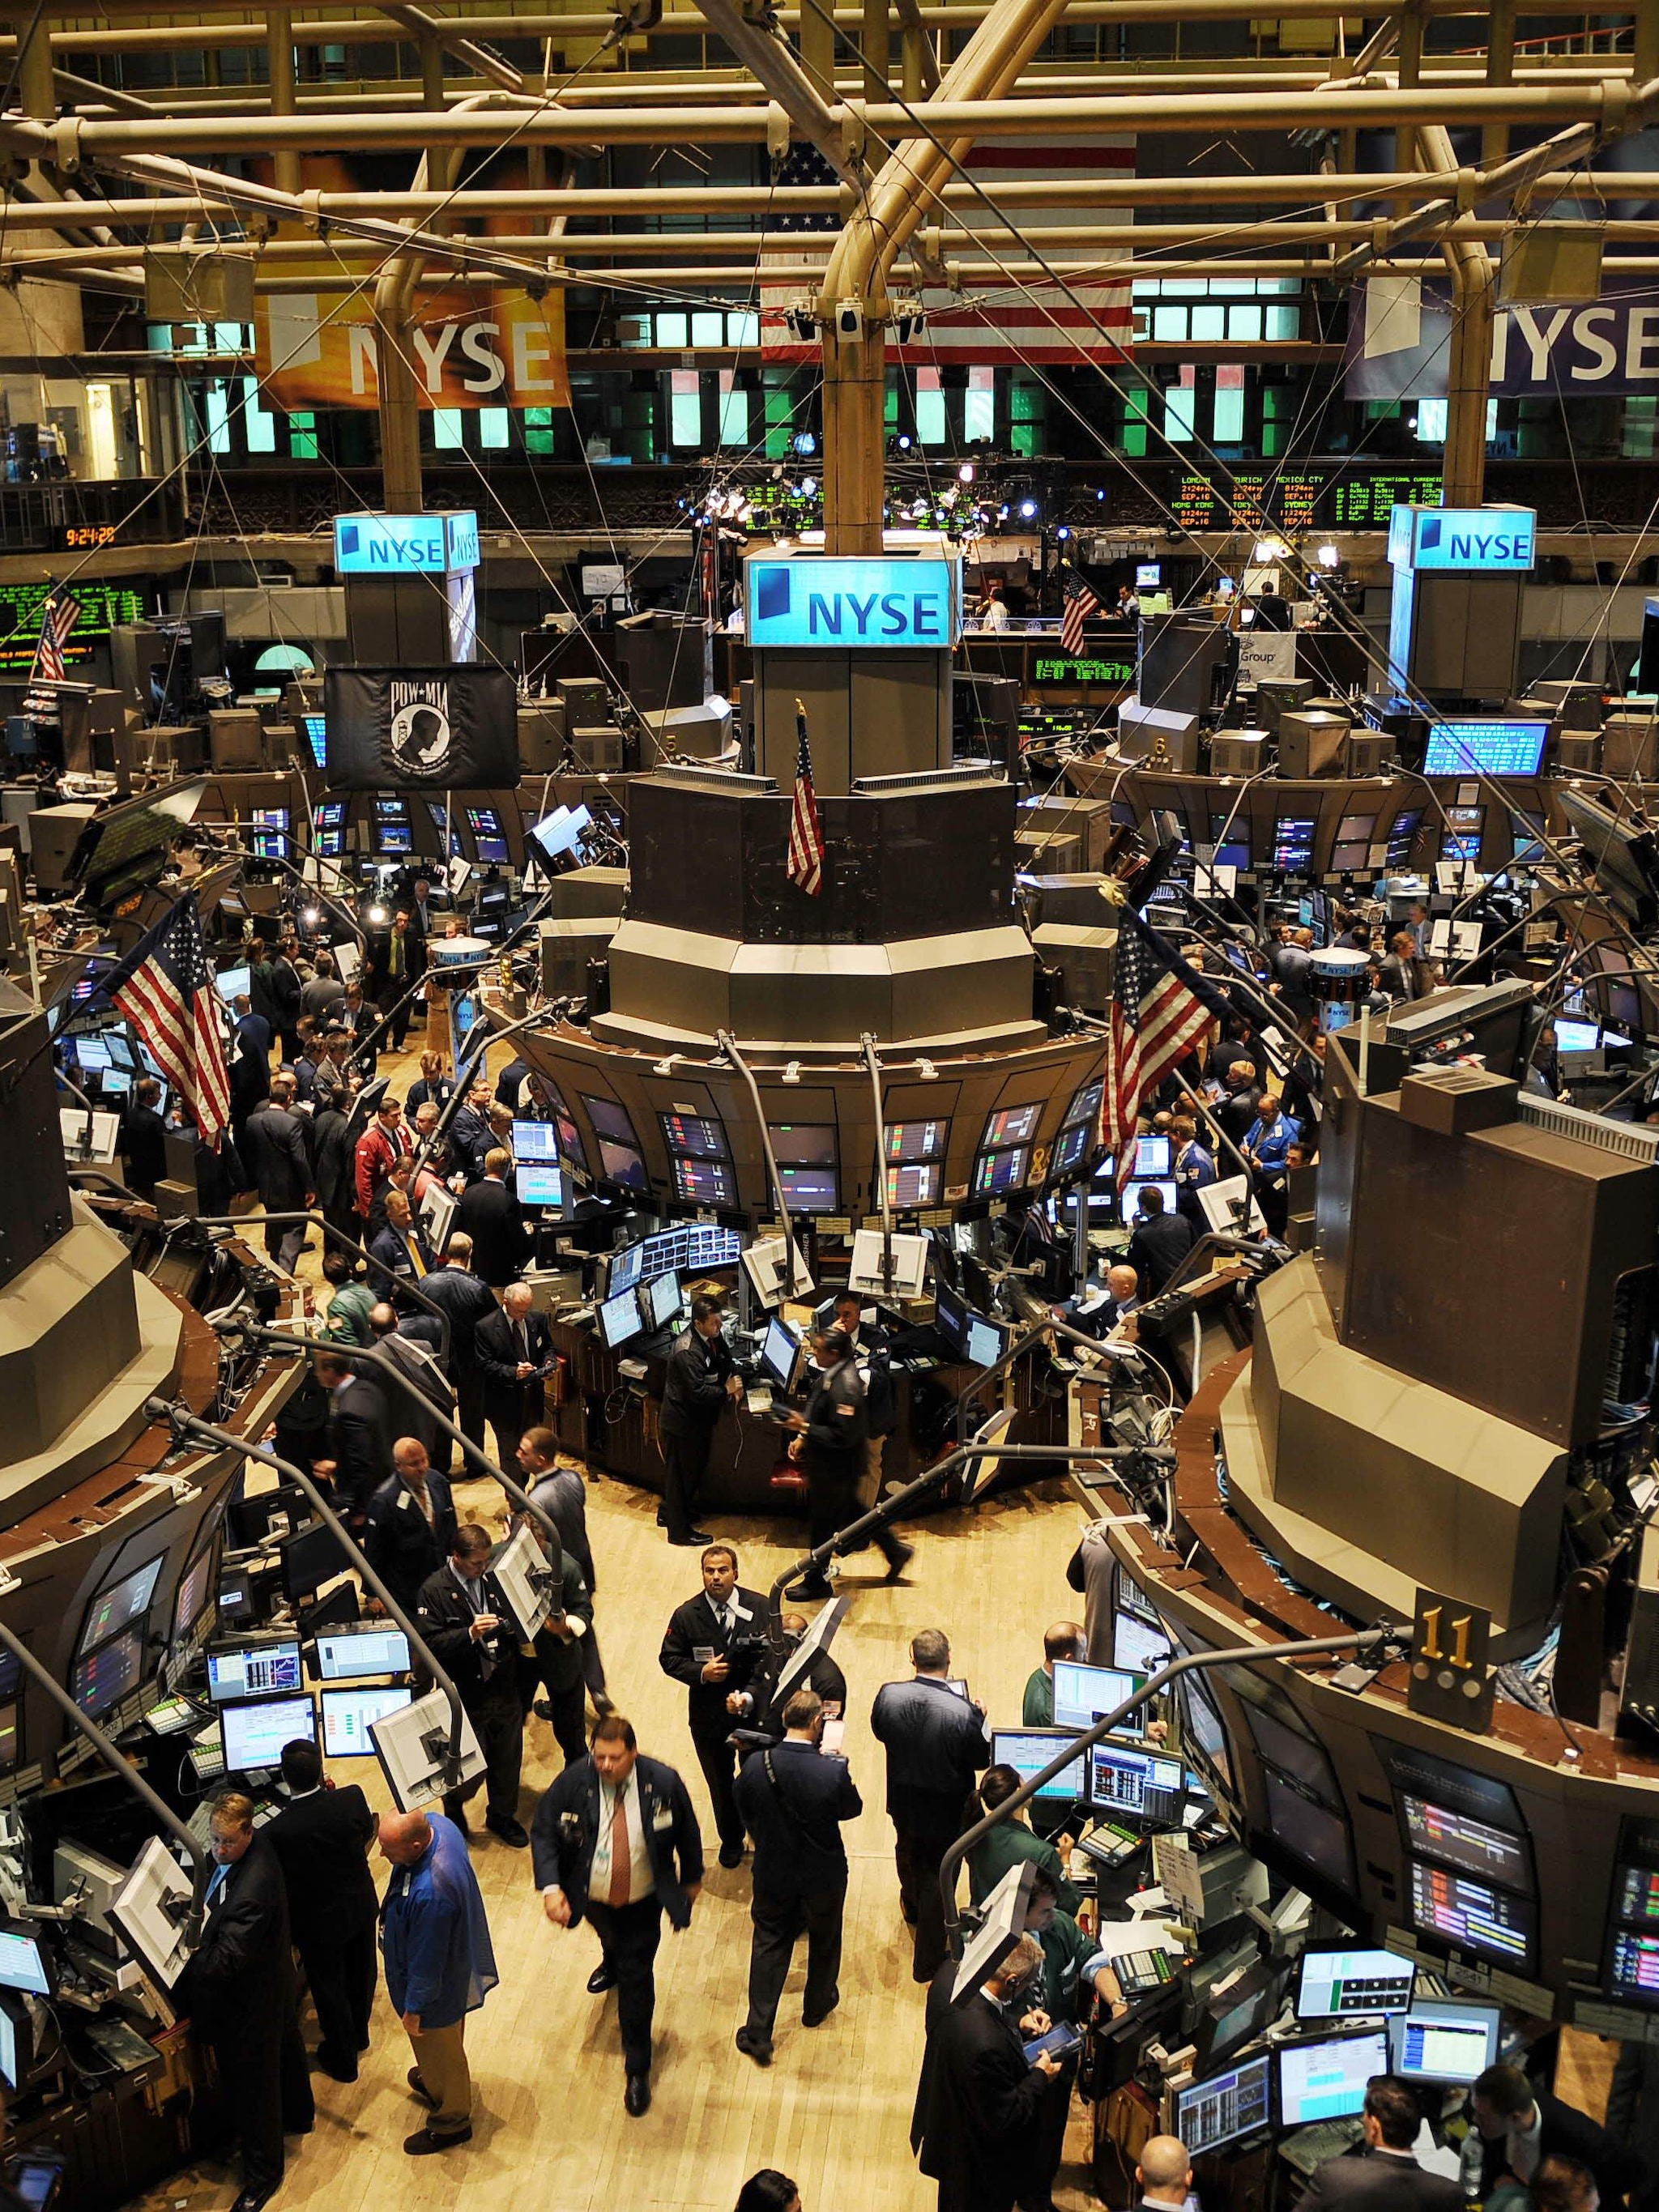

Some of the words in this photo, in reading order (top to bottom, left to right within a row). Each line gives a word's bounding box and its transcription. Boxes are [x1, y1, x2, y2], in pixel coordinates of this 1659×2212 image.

[349, 322, 554, 394] NYSE
[369, 539, 442, 564] NYSE
[457, 533, 477, 561] NYSE
[1451, 535, 1529, 560] NYSE
[808, 593, 940, 635] NYSE
[1241, 651, 1274, 663] Group
[390, 682, 419, 719] POW
[425, 682, 450, 719] MIA
[1155, 737, 1166, 755] 6
[1421, 1606, 1474, 1669] 11
